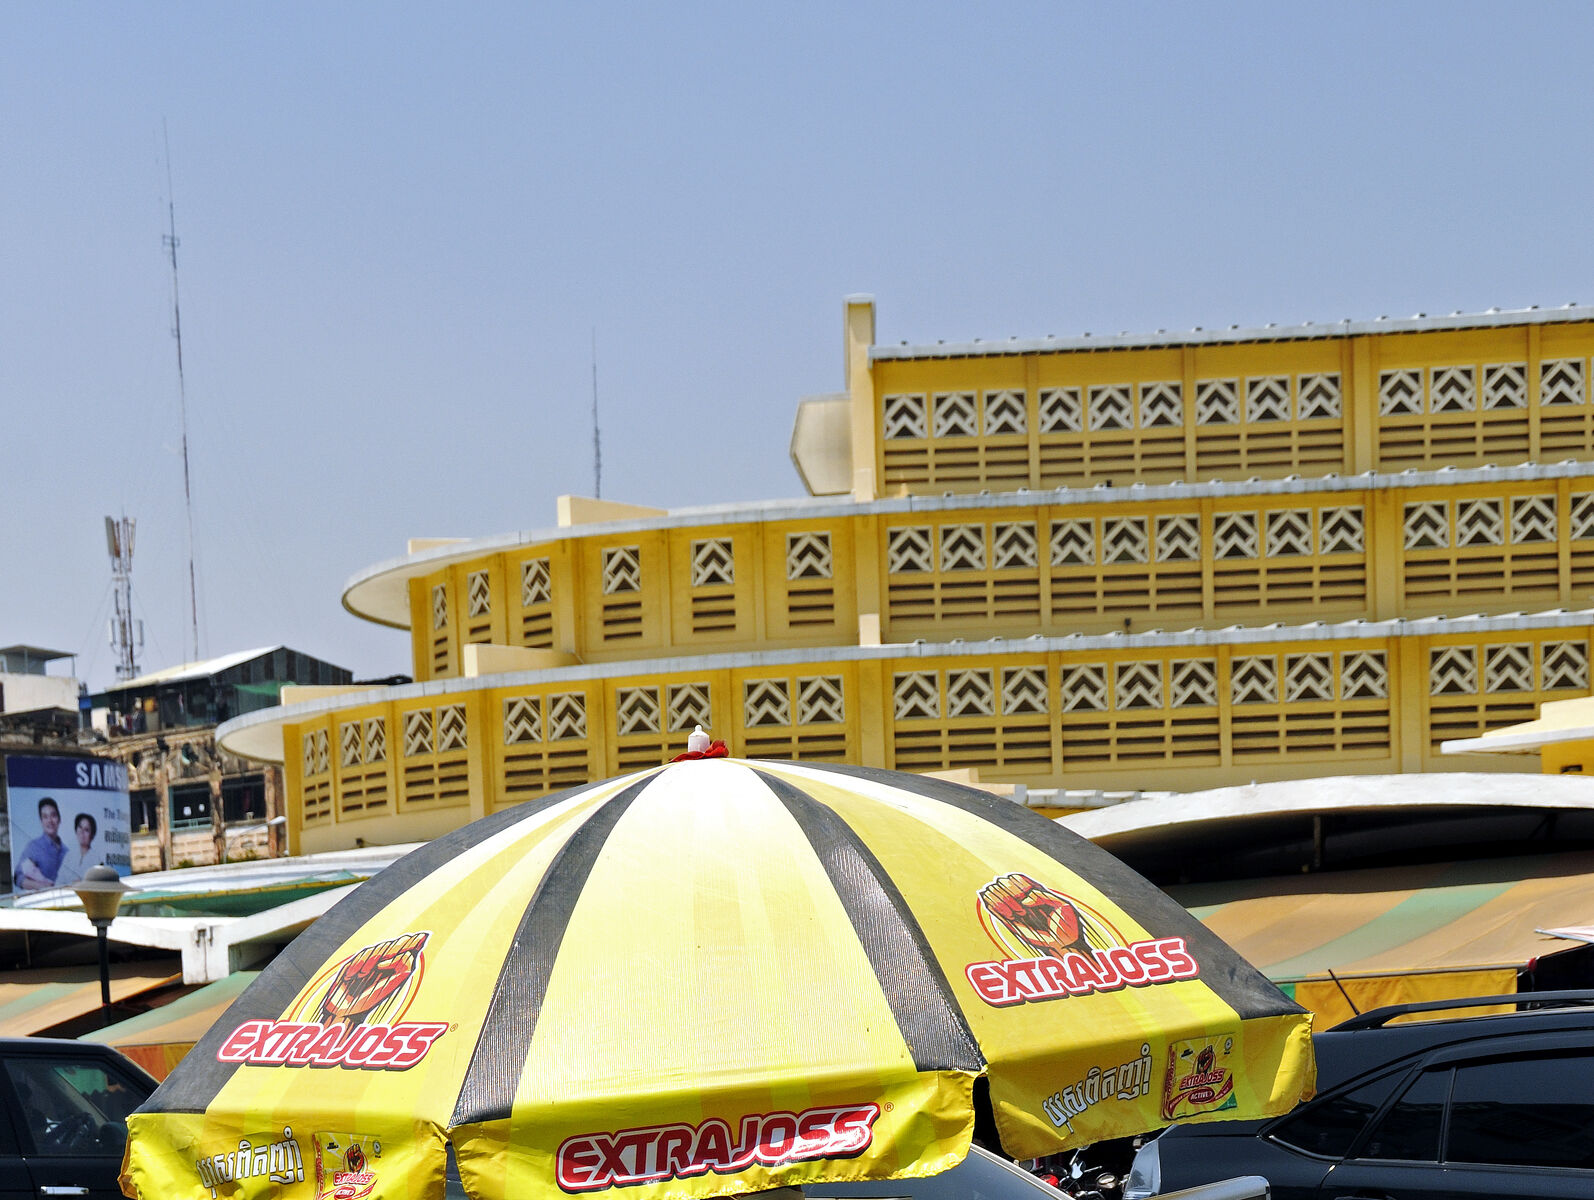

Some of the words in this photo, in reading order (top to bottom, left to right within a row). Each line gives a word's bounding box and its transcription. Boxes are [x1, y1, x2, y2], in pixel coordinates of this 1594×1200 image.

[965, 937, 1200, 1007] EXTRAJOSS
[217, 1019, 449, 1069] EXTRAJOSS
[556, 1103, 880, 1192] EXTRAJOSS
